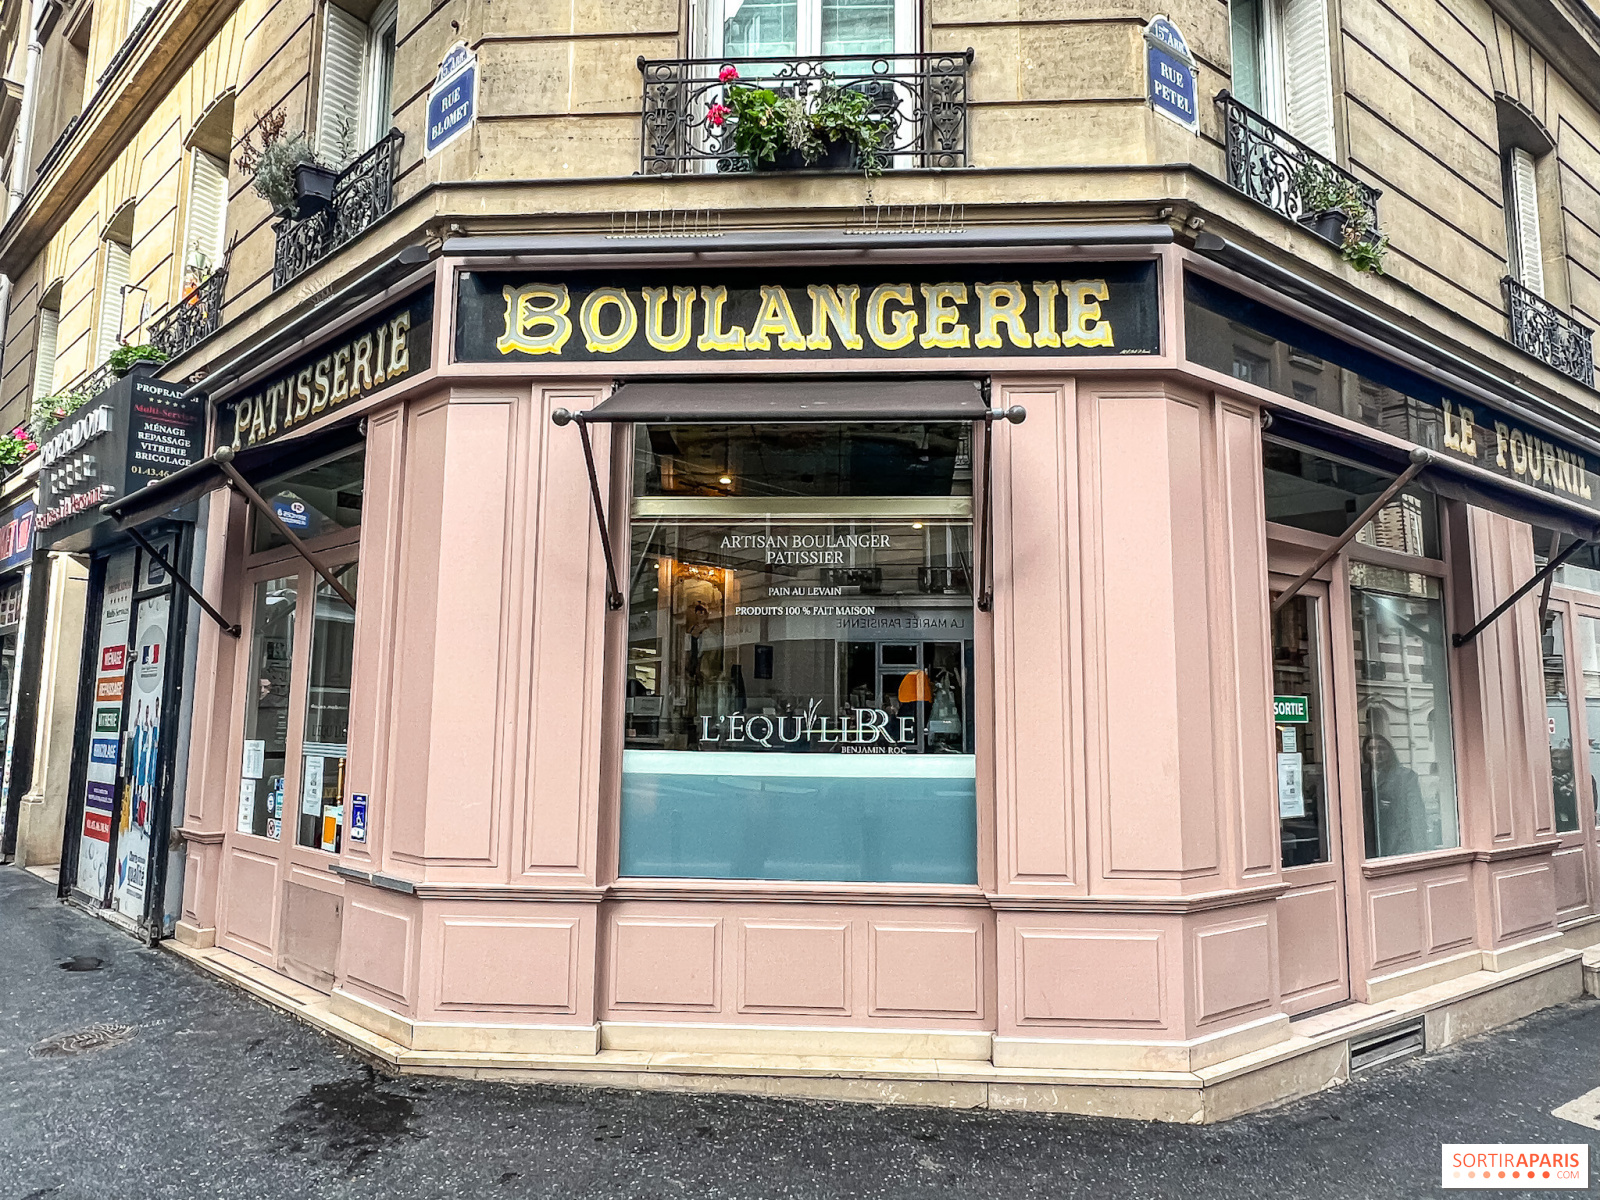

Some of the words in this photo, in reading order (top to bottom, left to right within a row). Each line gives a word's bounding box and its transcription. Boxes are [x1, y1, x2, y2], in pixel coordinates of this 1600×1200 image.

[1160, 61, 1184, 89] RUE
[441, 86, 461, 113] RUE
[1153, 79, 1192, 115] PETEL
[431, 101, 470, 140] BLOMET
[496, 278, 1115, 355] BOULANGERIE
[232, 309, 411, 452] PATISSERIE
[136, 382, 199, 403] PROPRAD
[144, 422, 186, 437] MÉNAGE
[137, 431, 191, 448] REPASSAGE
[140, 441, 187, 457] VITRERIE
[1441, 397, 1478, 458] LE
[1494, 419, 1592, 501] FOURNIL
[135, 451, 191, 467] BRICOLAGE
[720, 535, 788, 549] ARTISAN
[792, 534, 891, 549] BOULANGER
[766, 551, 845, 565] PATISSIER
[768, 587, 790, 596] PAIN
[792, 587, 806, 596] AU
[807, 587, 842, 596] LEVAIN
[735, 606, 784, 616] PRODUITS
[785, 606, 801, 616] 100
[803, 607, 811, 616] %
[813, 606, 835, 616] FAIT
[836, 606, 876, 616] MAISON
[1273, 702, 1305, 716] SORTIE
[841, 746, 886, 754] BENJAMIN
[888, 746, 907, 755] ROC
